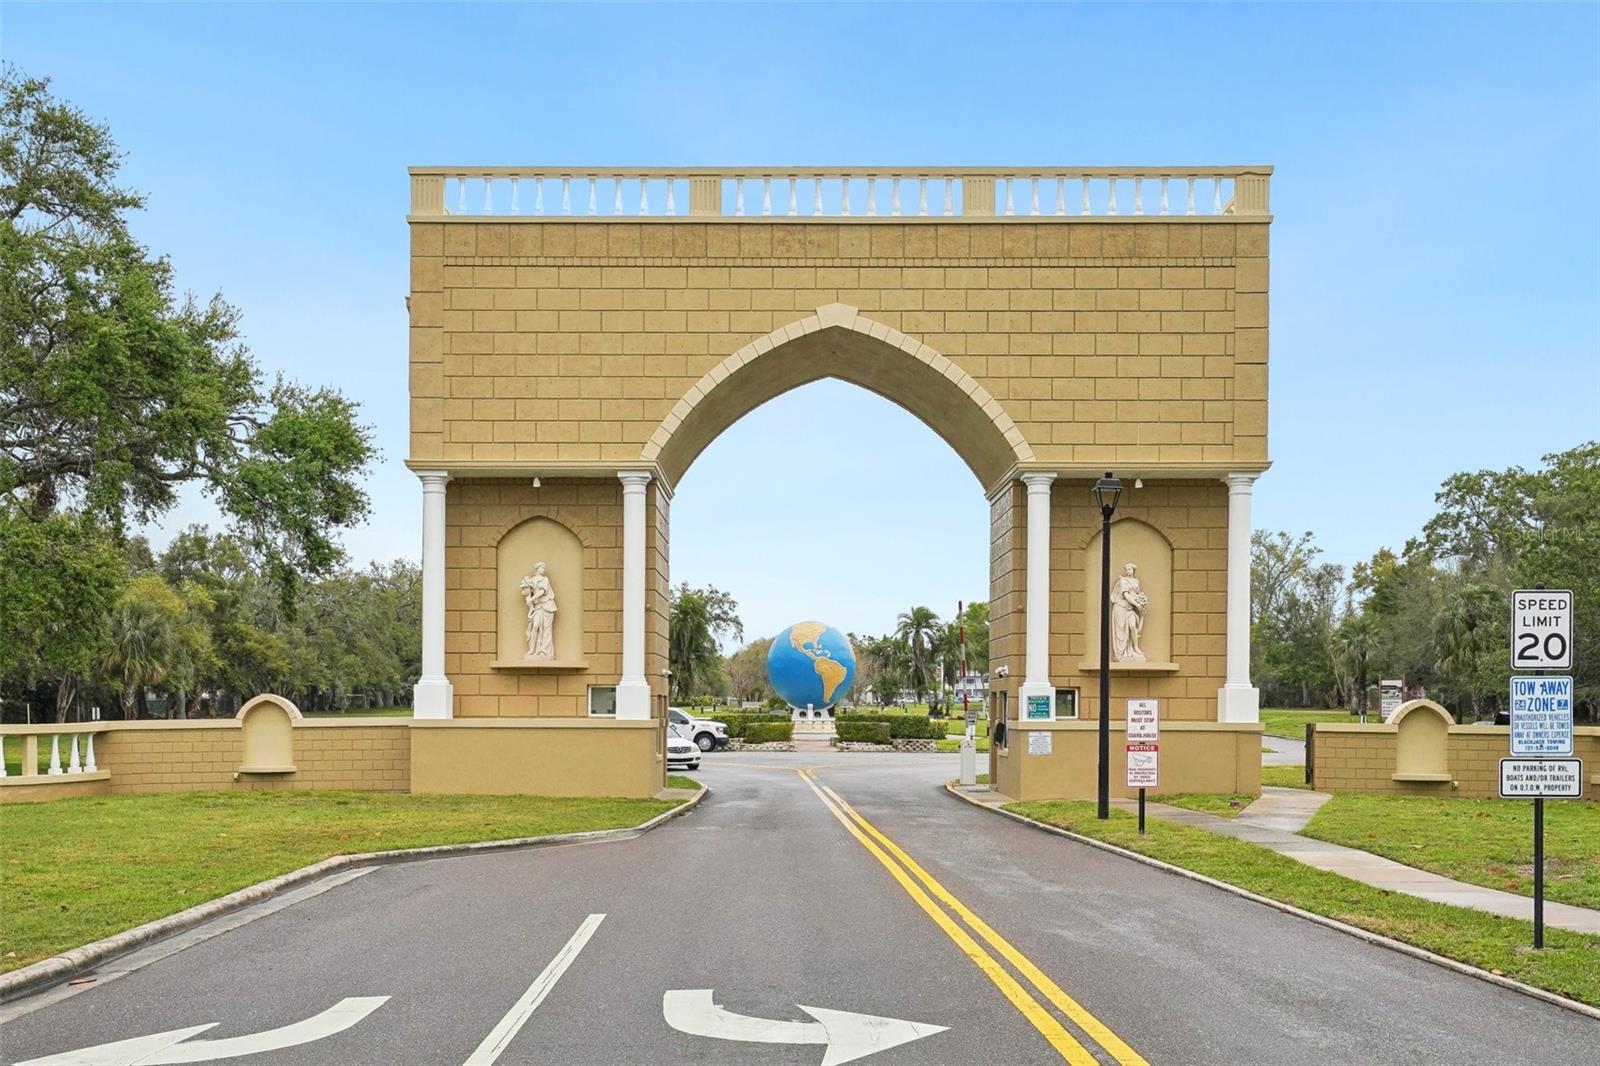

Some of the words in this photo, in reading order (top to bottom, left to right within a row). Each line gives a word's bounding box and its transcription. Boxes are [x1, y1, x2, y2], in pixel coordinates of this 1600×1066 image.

[1518, 599, 1567, 610] SPEED
[1523, 616, 1561, 627] LIMIT
[1517, 632, 1567, 661] 20
[1514, 681, 1536, 696] TOW
[1541, 681, 1569, 696] AWAY
[1027, 704, 1037, 712] NO
[1527, 697, 1556, 712] ZONE
